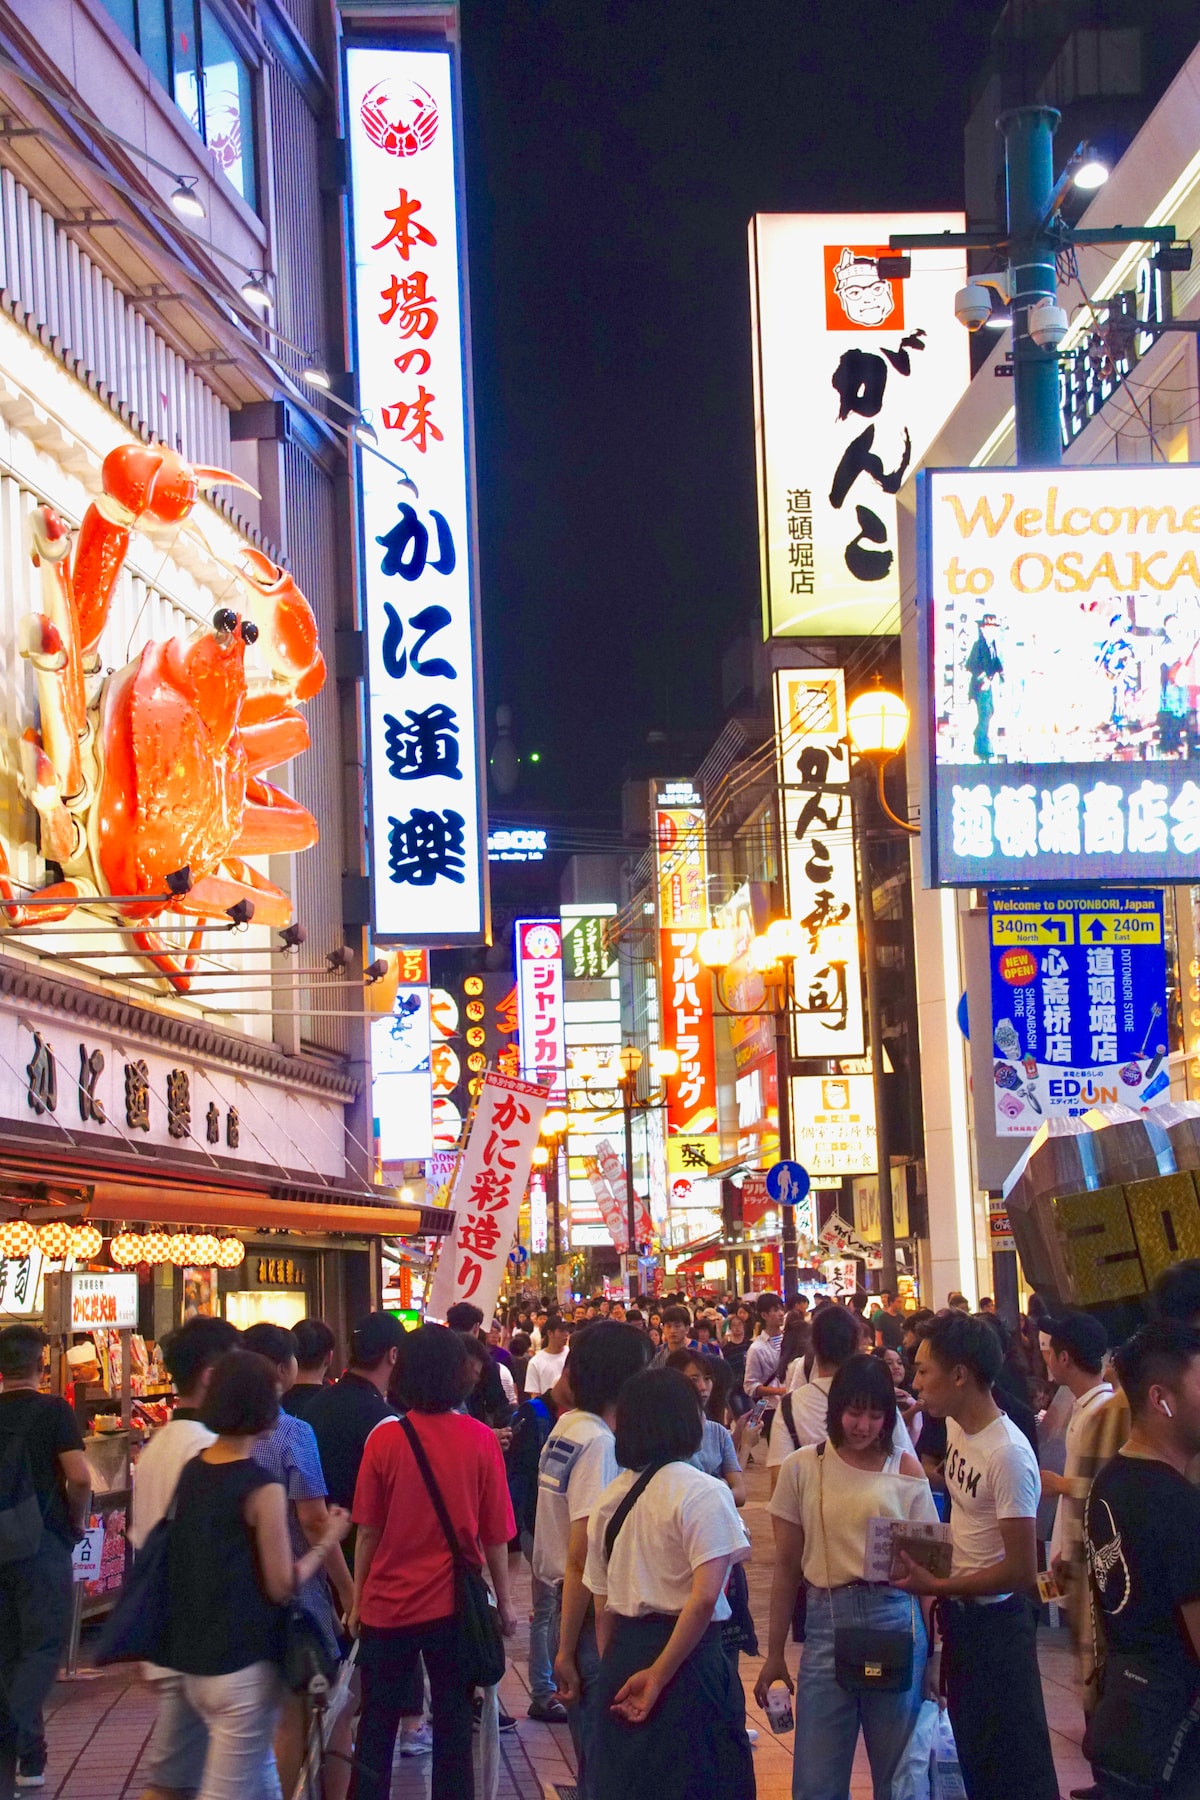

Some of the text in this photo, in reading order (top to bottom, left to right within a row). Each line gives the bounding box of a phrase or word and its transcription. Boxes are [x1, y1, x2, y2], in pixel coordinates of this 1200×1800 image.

[371, 187, 444, 455] 本場の味
[828, 328, 928, 581] がんこ
[941, 485, 1200, 538] Welcome
[786, 488, 815, 596] 道頓堀店
[943, 550, 1200, 595] to OSAKA
[993, 900, 1040, 911] Welcome
[1043, 899, 1055, 910] to
[1124, 899, 1155, 912] Japan
[996, 919, 1038, 933] 340m
[1113, 918, 1154, 932] 240m
[1114, 933, 1131, 941] East
[1003, 964, 1035, 980] OPEN!
[1005, 954, 1029, 968] NEW
[1013, 988, 1024, 1018] STORE
[1121, 948, 1134, 1032] DOTONBORI STORE
[533, 963, 558, 1089] ジャンカラ
[671, 932, 706, 1109] ツルハドラッグ
[1025, 988, 1037, 1050] SHINSAIBASHI
[1049, 1079, 1118, 1105] EDION
[457, 1093, 532, 1300] かに彩造り
[80, 1537, 92, 1562] 入口
[73, 1562, 96, 1570] Entrance
[1123, 1669, 1149, 1684] Supreme
